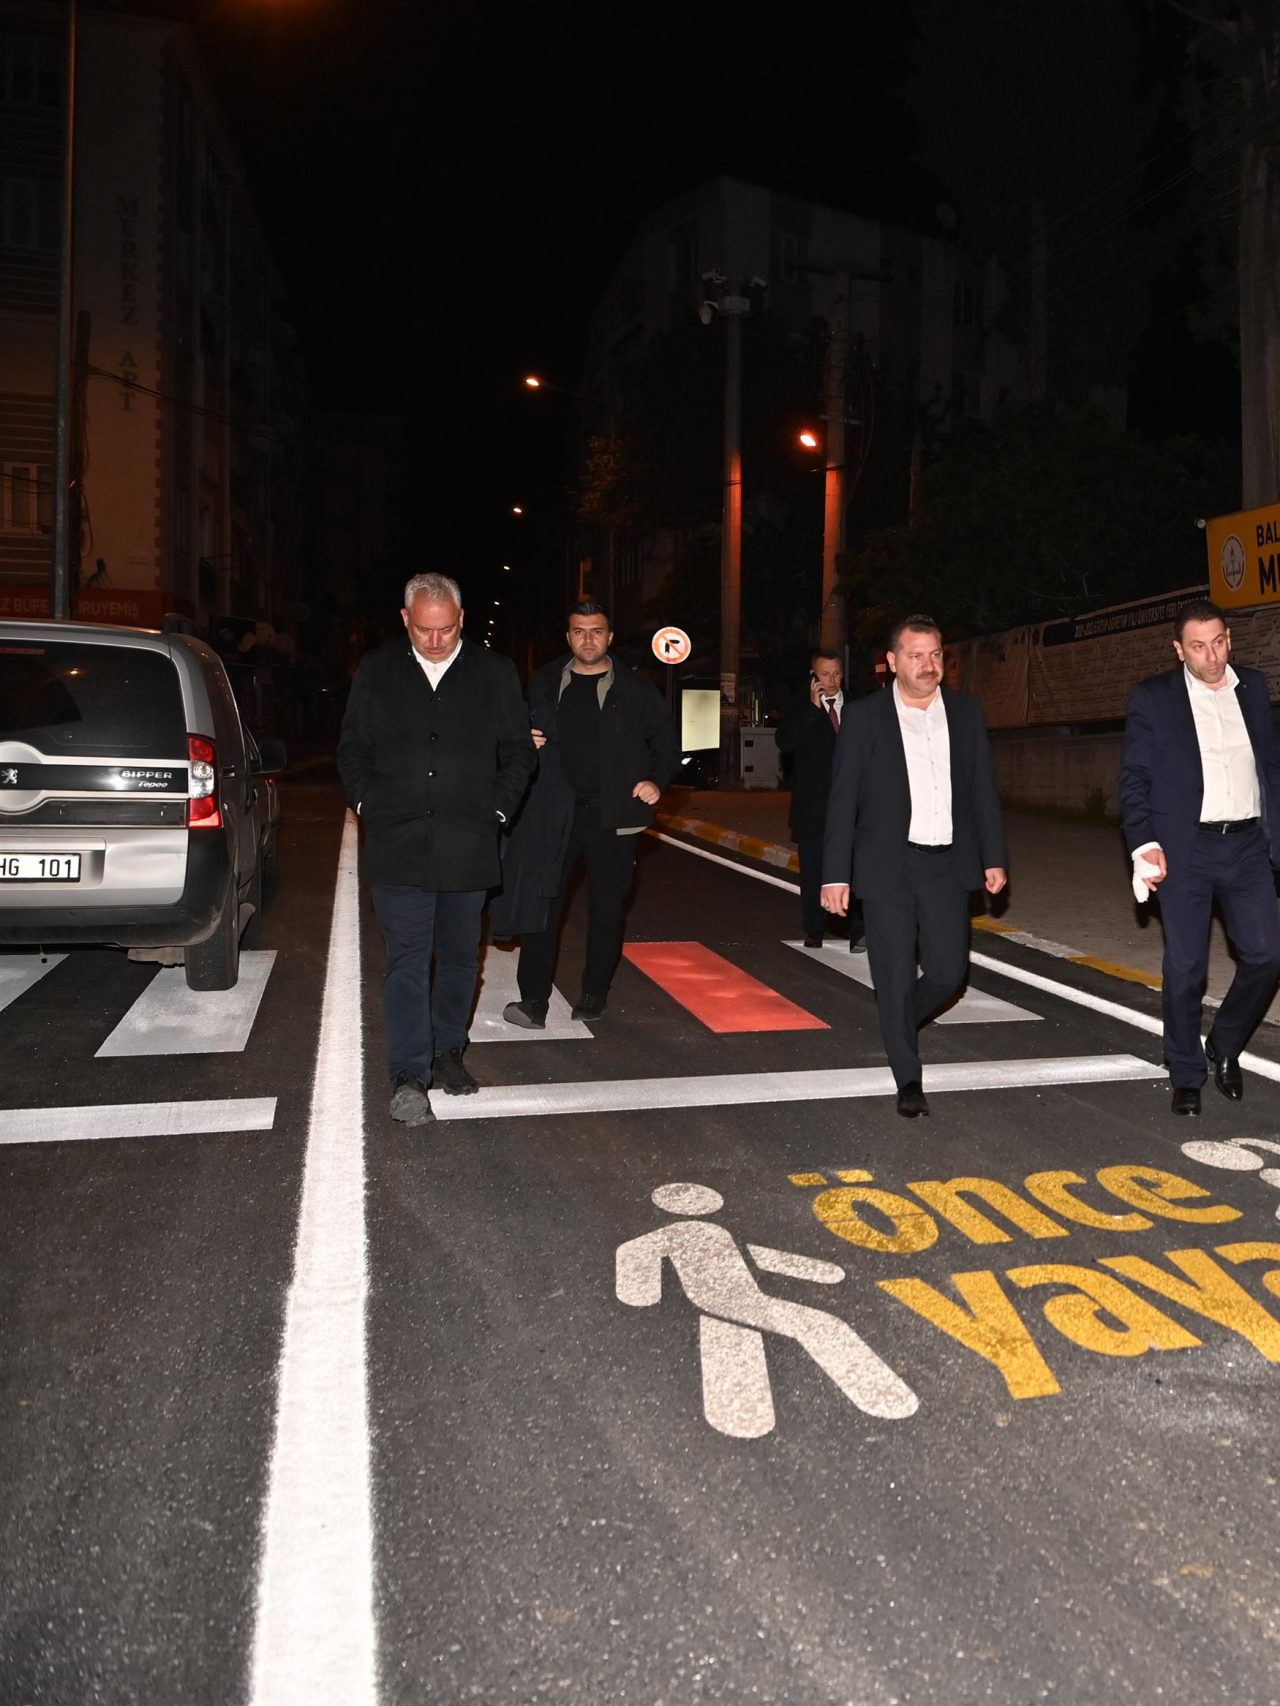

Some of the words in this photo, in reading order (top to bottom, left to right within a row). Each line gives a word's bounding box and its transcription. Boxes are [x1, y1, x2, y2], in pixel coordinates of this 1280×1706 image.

[118, 196, 139, 325] MERKEZ
[14, 595, 49, 613] BÜFE
[121, 770, 173, 779] BIPPER
[138, 780, 169, 789] Tepee
[39, 858, 71, 878] 101
[788, 1165, 1243, 1254] önce
